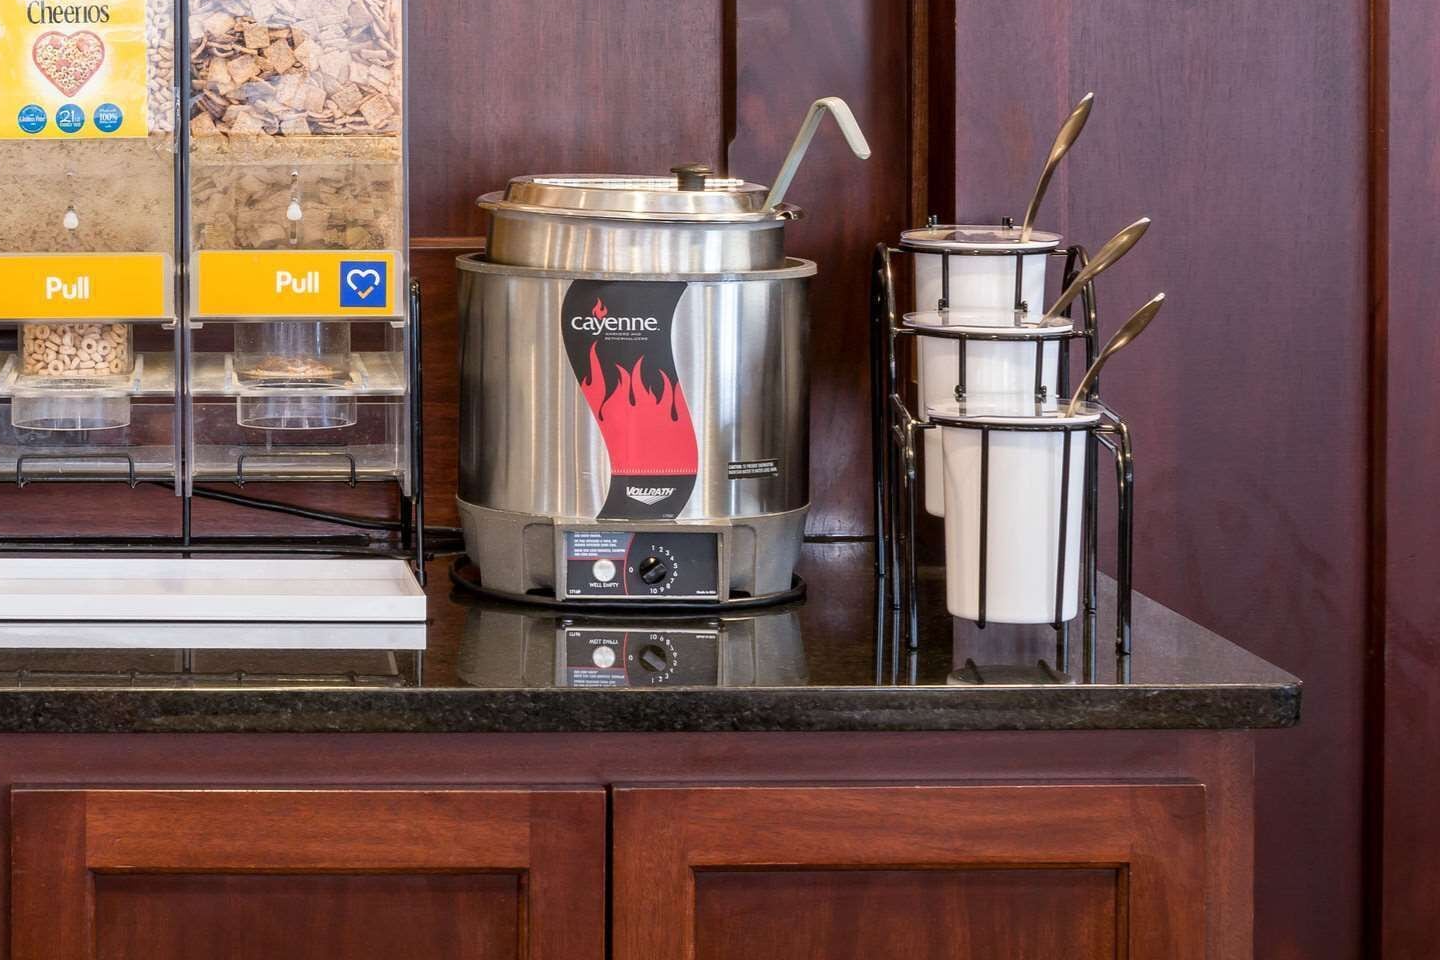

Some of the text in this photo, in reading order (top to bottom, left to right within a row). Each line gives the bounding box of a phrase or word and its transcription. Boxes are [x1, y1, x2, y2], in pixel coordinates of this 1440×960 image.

[27, 0, 110, 24] Cheerios
[46, 277, 90, 299] Pull
[276, 271, 320, 293] Pull
[626, 486, 675, 496] VOLLRATH
